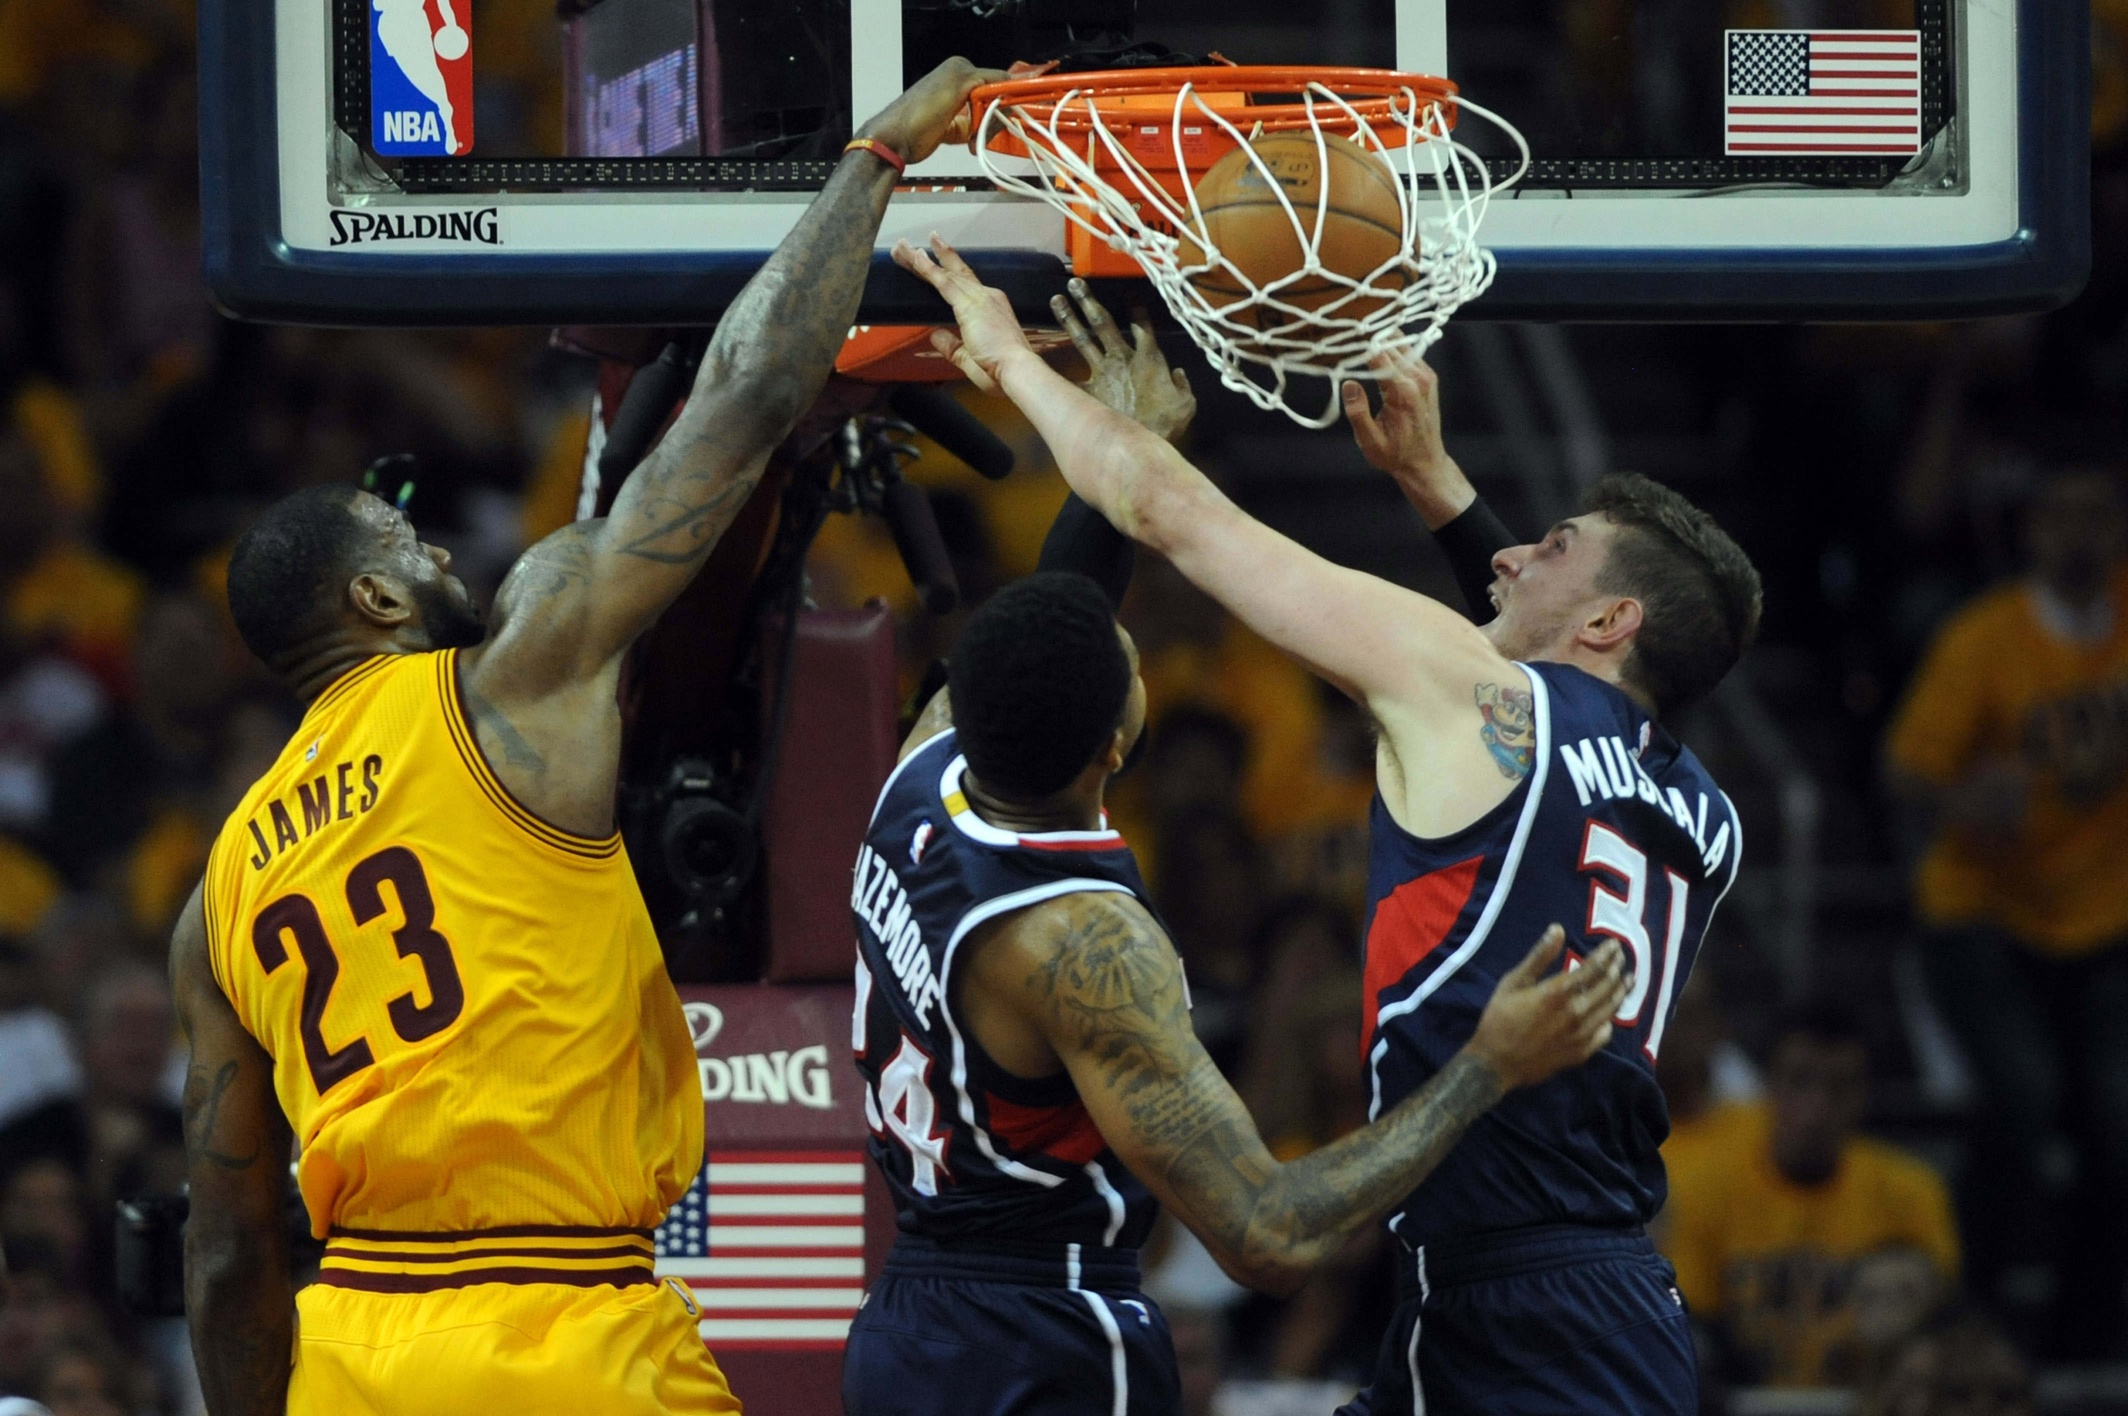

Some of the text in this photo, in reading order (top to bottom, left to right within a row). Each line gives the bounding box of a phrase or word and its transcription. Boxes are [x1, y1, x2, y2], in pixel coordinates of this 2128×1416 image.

[384, 111, 441, 142] NBA
[329, 207, 498, 246] SPALDING
[247, 754, 383, 871] JAMES
[251, 843, 466, 1097] 23
[850, 842, 941, 1031] AZEMORE
[1566, 819, 1689, 1065] 31
